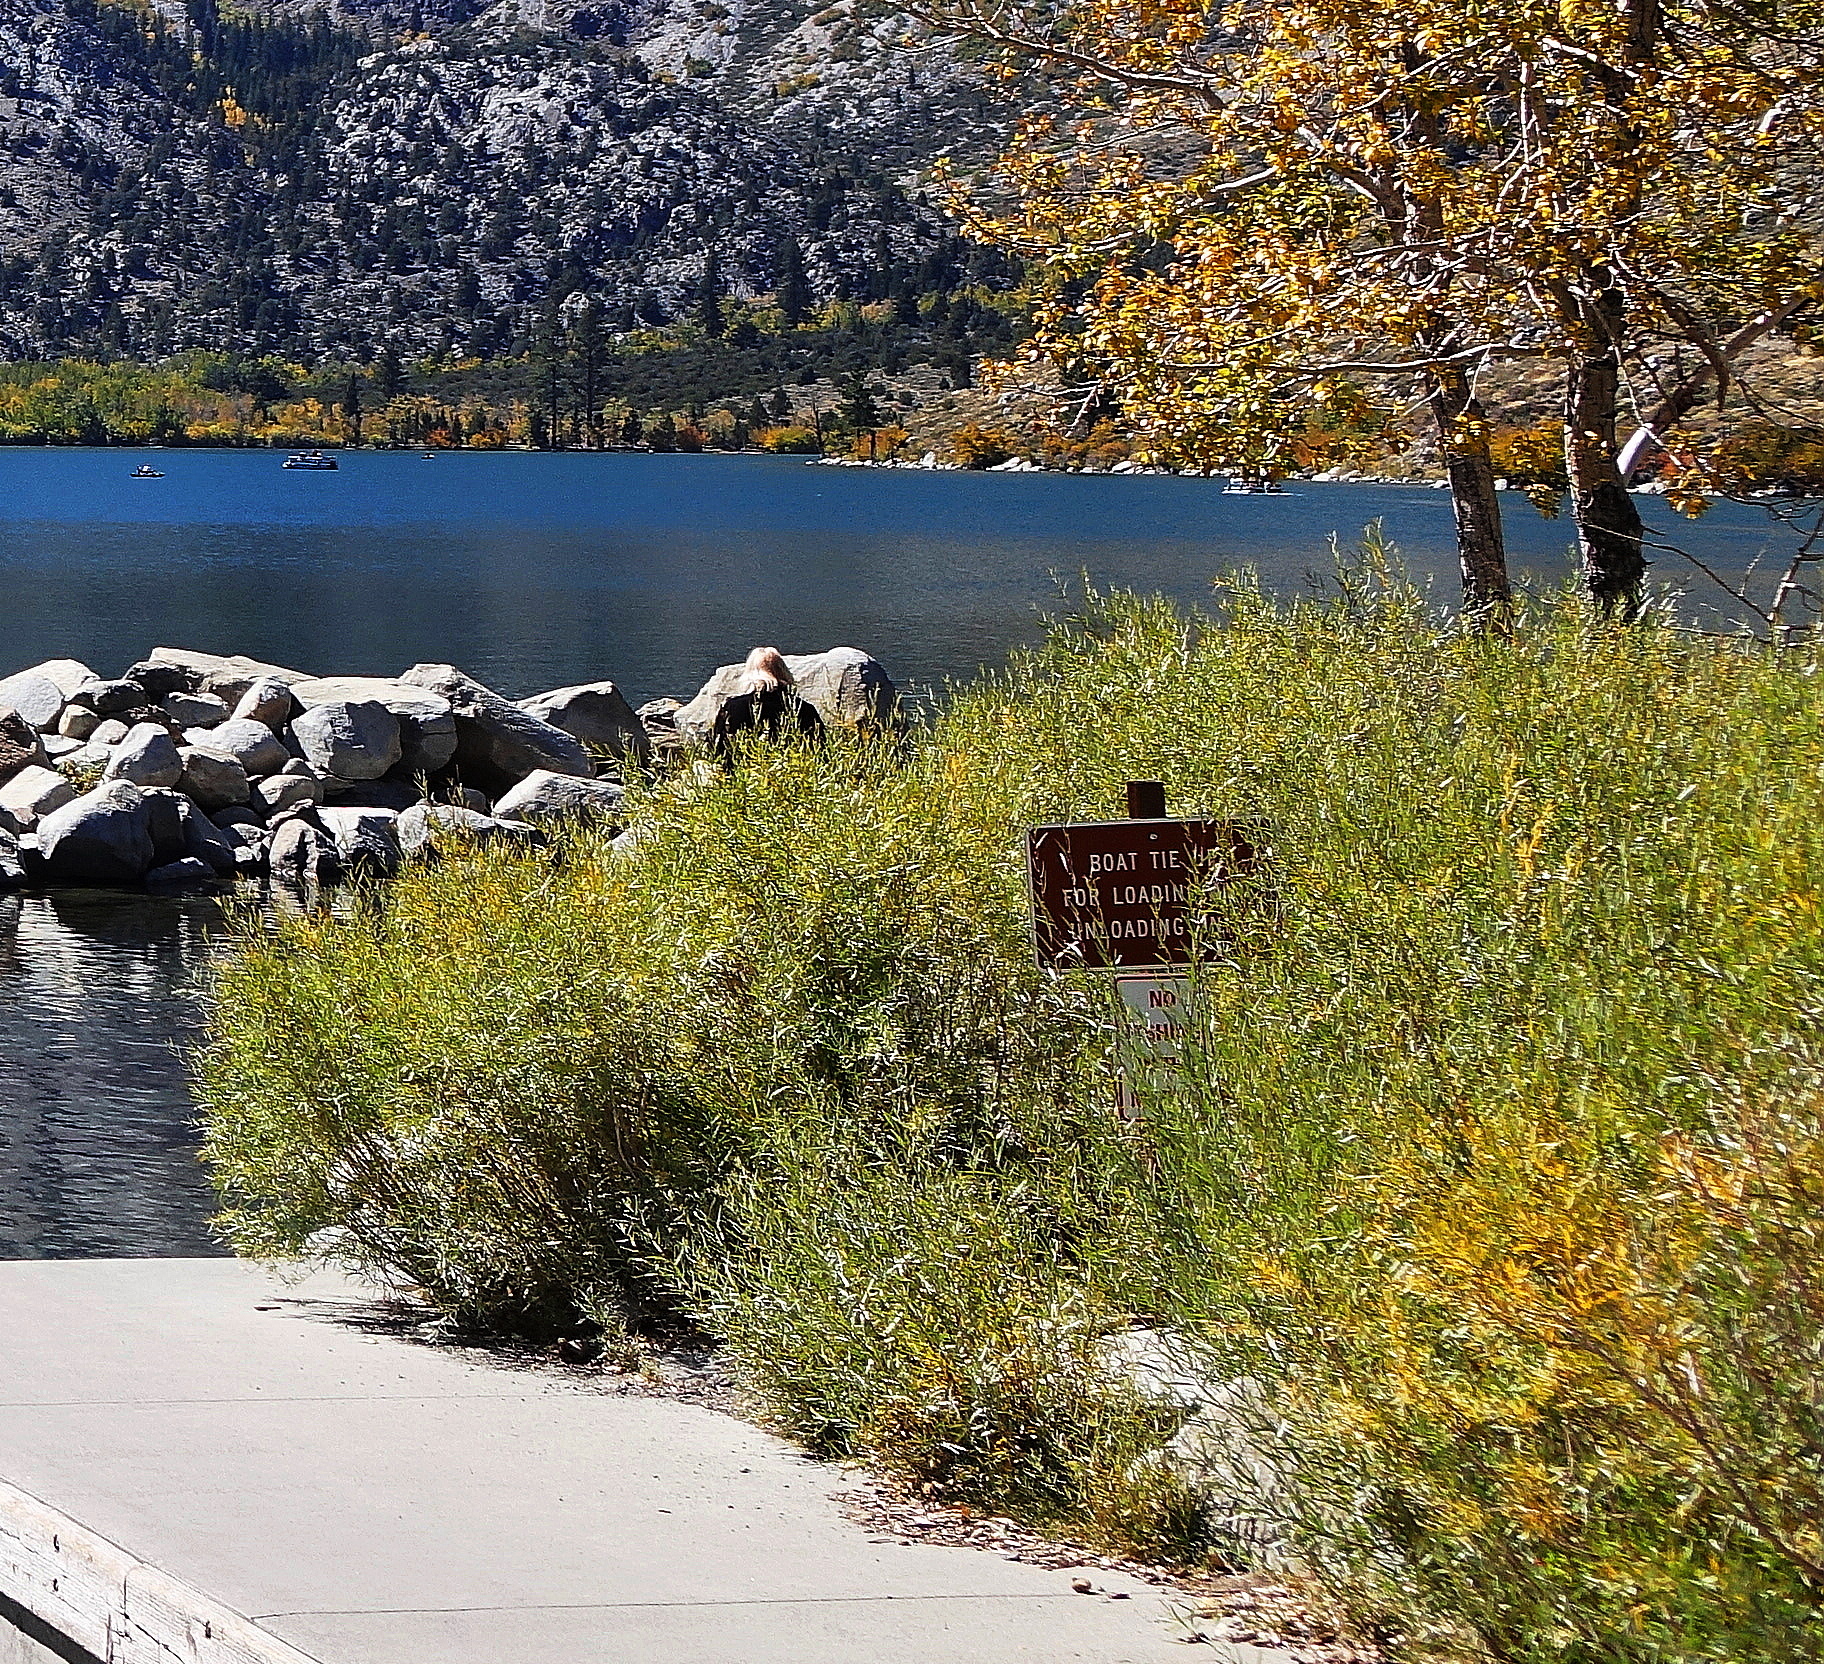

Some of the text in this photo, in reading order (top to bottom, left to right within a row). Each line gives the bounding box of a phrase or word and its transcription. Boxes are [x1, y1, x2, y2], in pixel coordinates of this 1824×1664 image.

[1089, 852, 1138, 872] BOAT
[1149, 850, 1181, 869] TIE
[1064, 884, 1192, 907] FOR LOADIN
[1149, 990, 1177, 1008] NO
